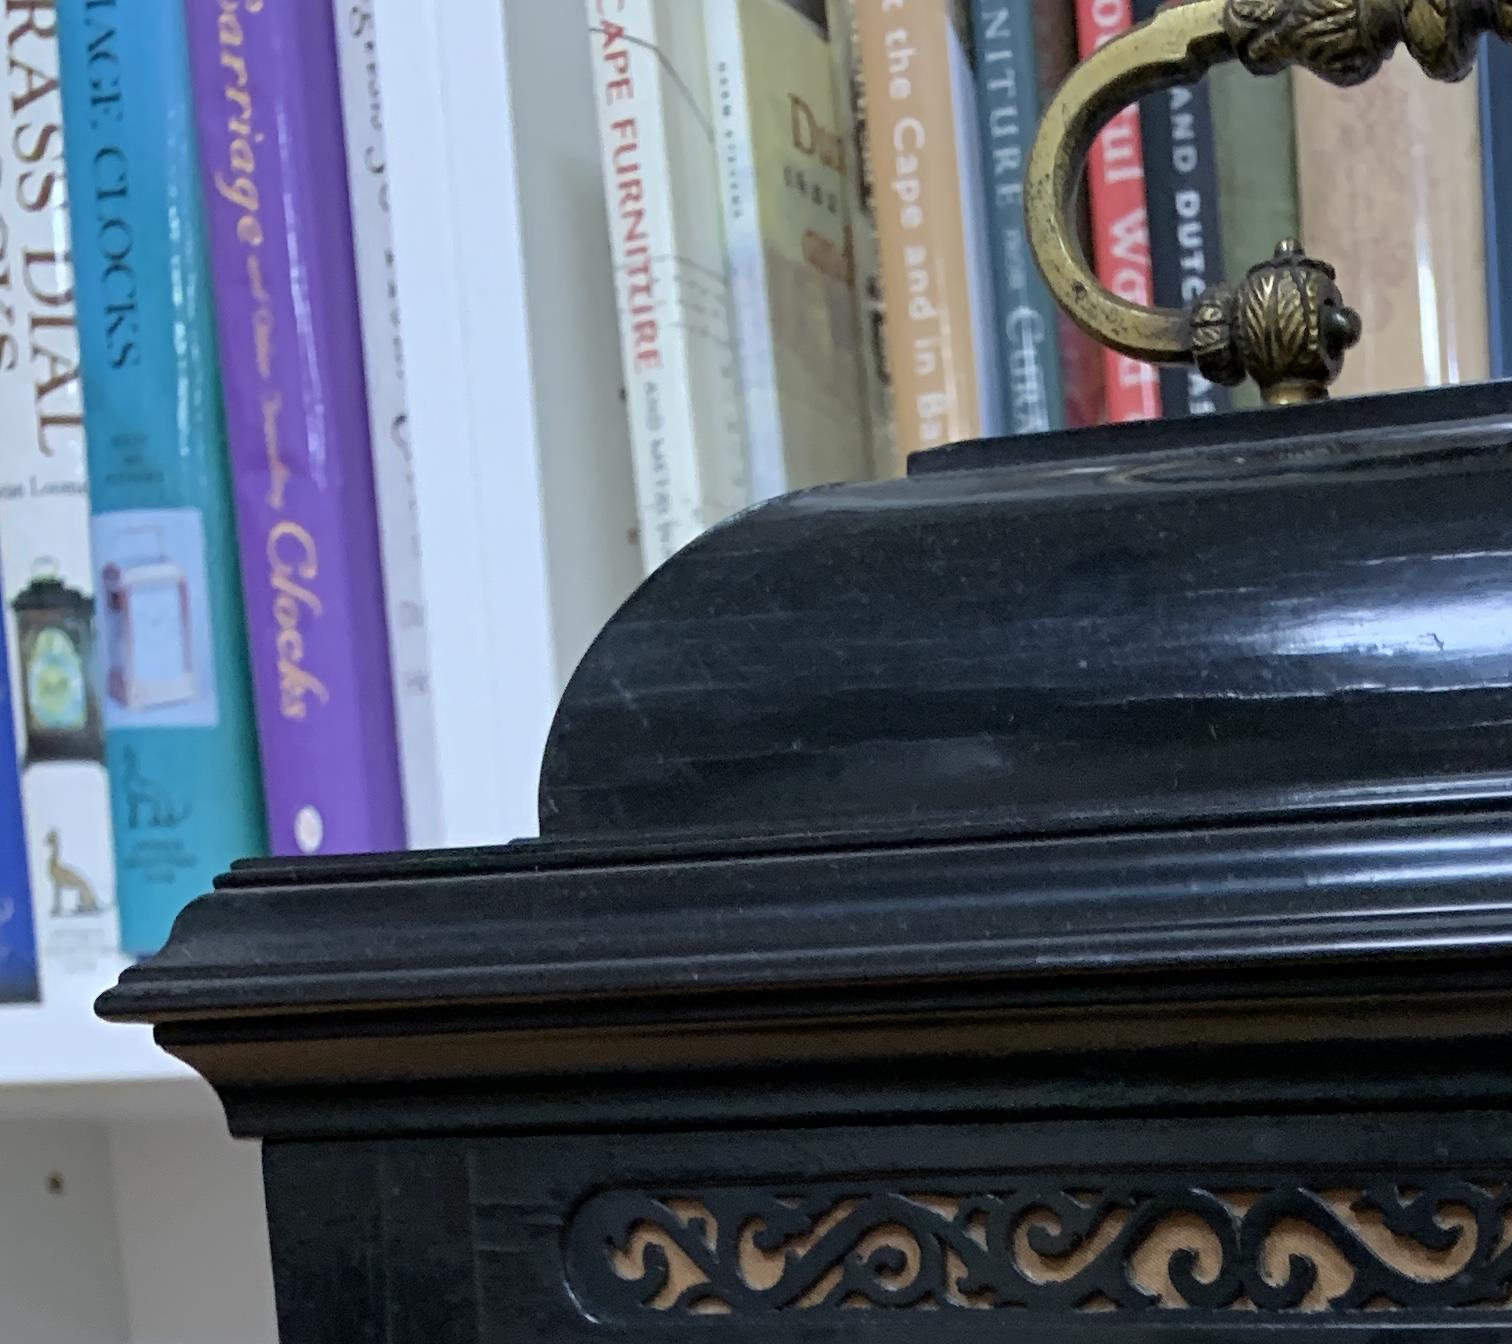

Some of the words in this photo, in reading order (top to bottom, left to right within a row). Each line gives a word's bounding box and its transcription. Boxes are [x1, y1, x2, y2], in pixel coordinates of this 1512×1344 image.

[885, 25, 916, 98] the
[982, 9, 1023, 208] NITURE
[890, 118, 925, 230] Cape
[1168, 86, 1197, 172] AND
[92, 146, 140, 371] CLOCKS
[608, 116, 664, 377] FURNITURE
[904, 243, 937, 322] and
[1175, 190, 1210, 303] DUTC
[22, 247, 84, 457] DIAL
[912, 337, 940, 378] in
[266, 521, 330, 720] Clocks
